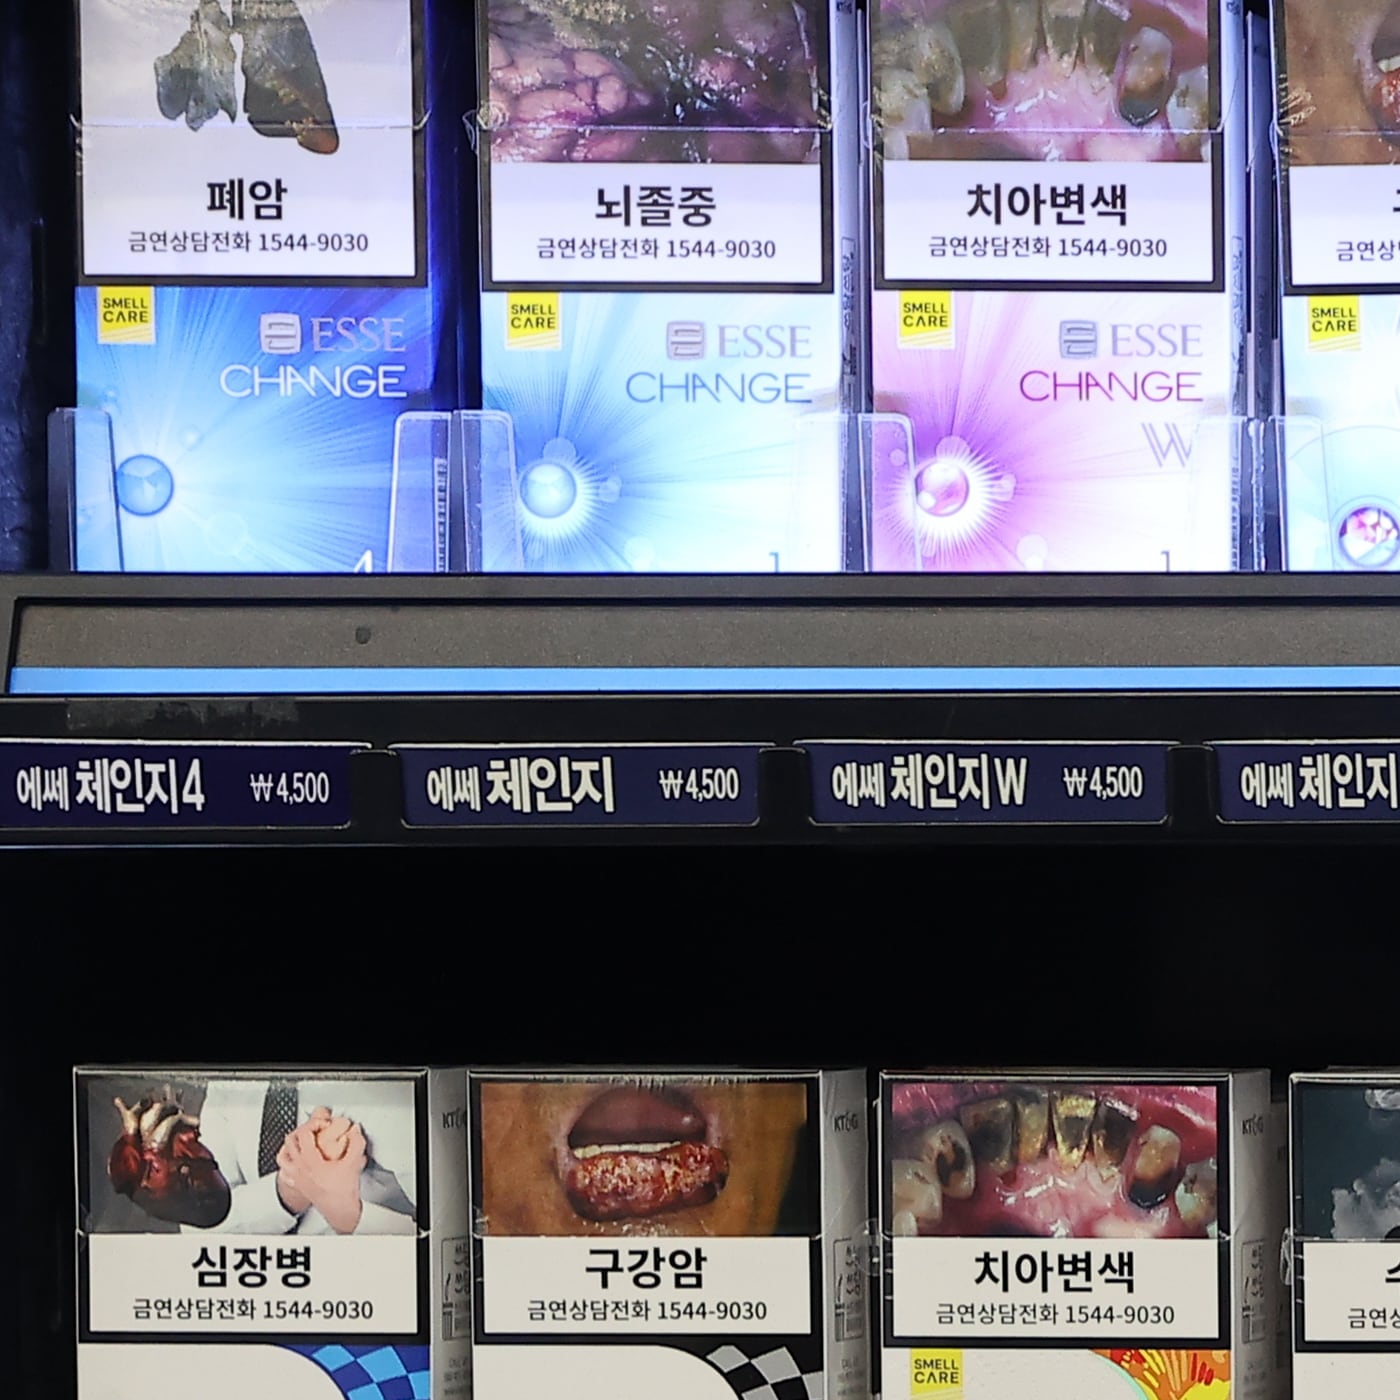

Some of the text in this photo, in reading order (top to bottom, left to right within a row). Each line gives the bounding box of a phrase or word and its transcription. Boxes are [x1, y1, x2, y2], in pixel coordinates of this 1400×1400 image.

[207, 178, 287, 220] 폐암
[596, 185, 716, 227] 뇌졸중
[968, 183, 1126, 226] 치아변색
[129, 231, 368, 252] 금연상담전화 1544-9030
[103, 298, 147, 309] SMELL
[103, 311, 147, 323] CARE
[718, 325, 811, 358] ESSE
[625, 372, 818, 408] CHANGE
[427, 757, 738, 812] 에쎄 체인지 ₩4,500
[192, 1246, 310, 1288] 심장병
[586, 1247, 707, 1289] 구강암
[975, 1251, 1133, 1293] 치아변색
